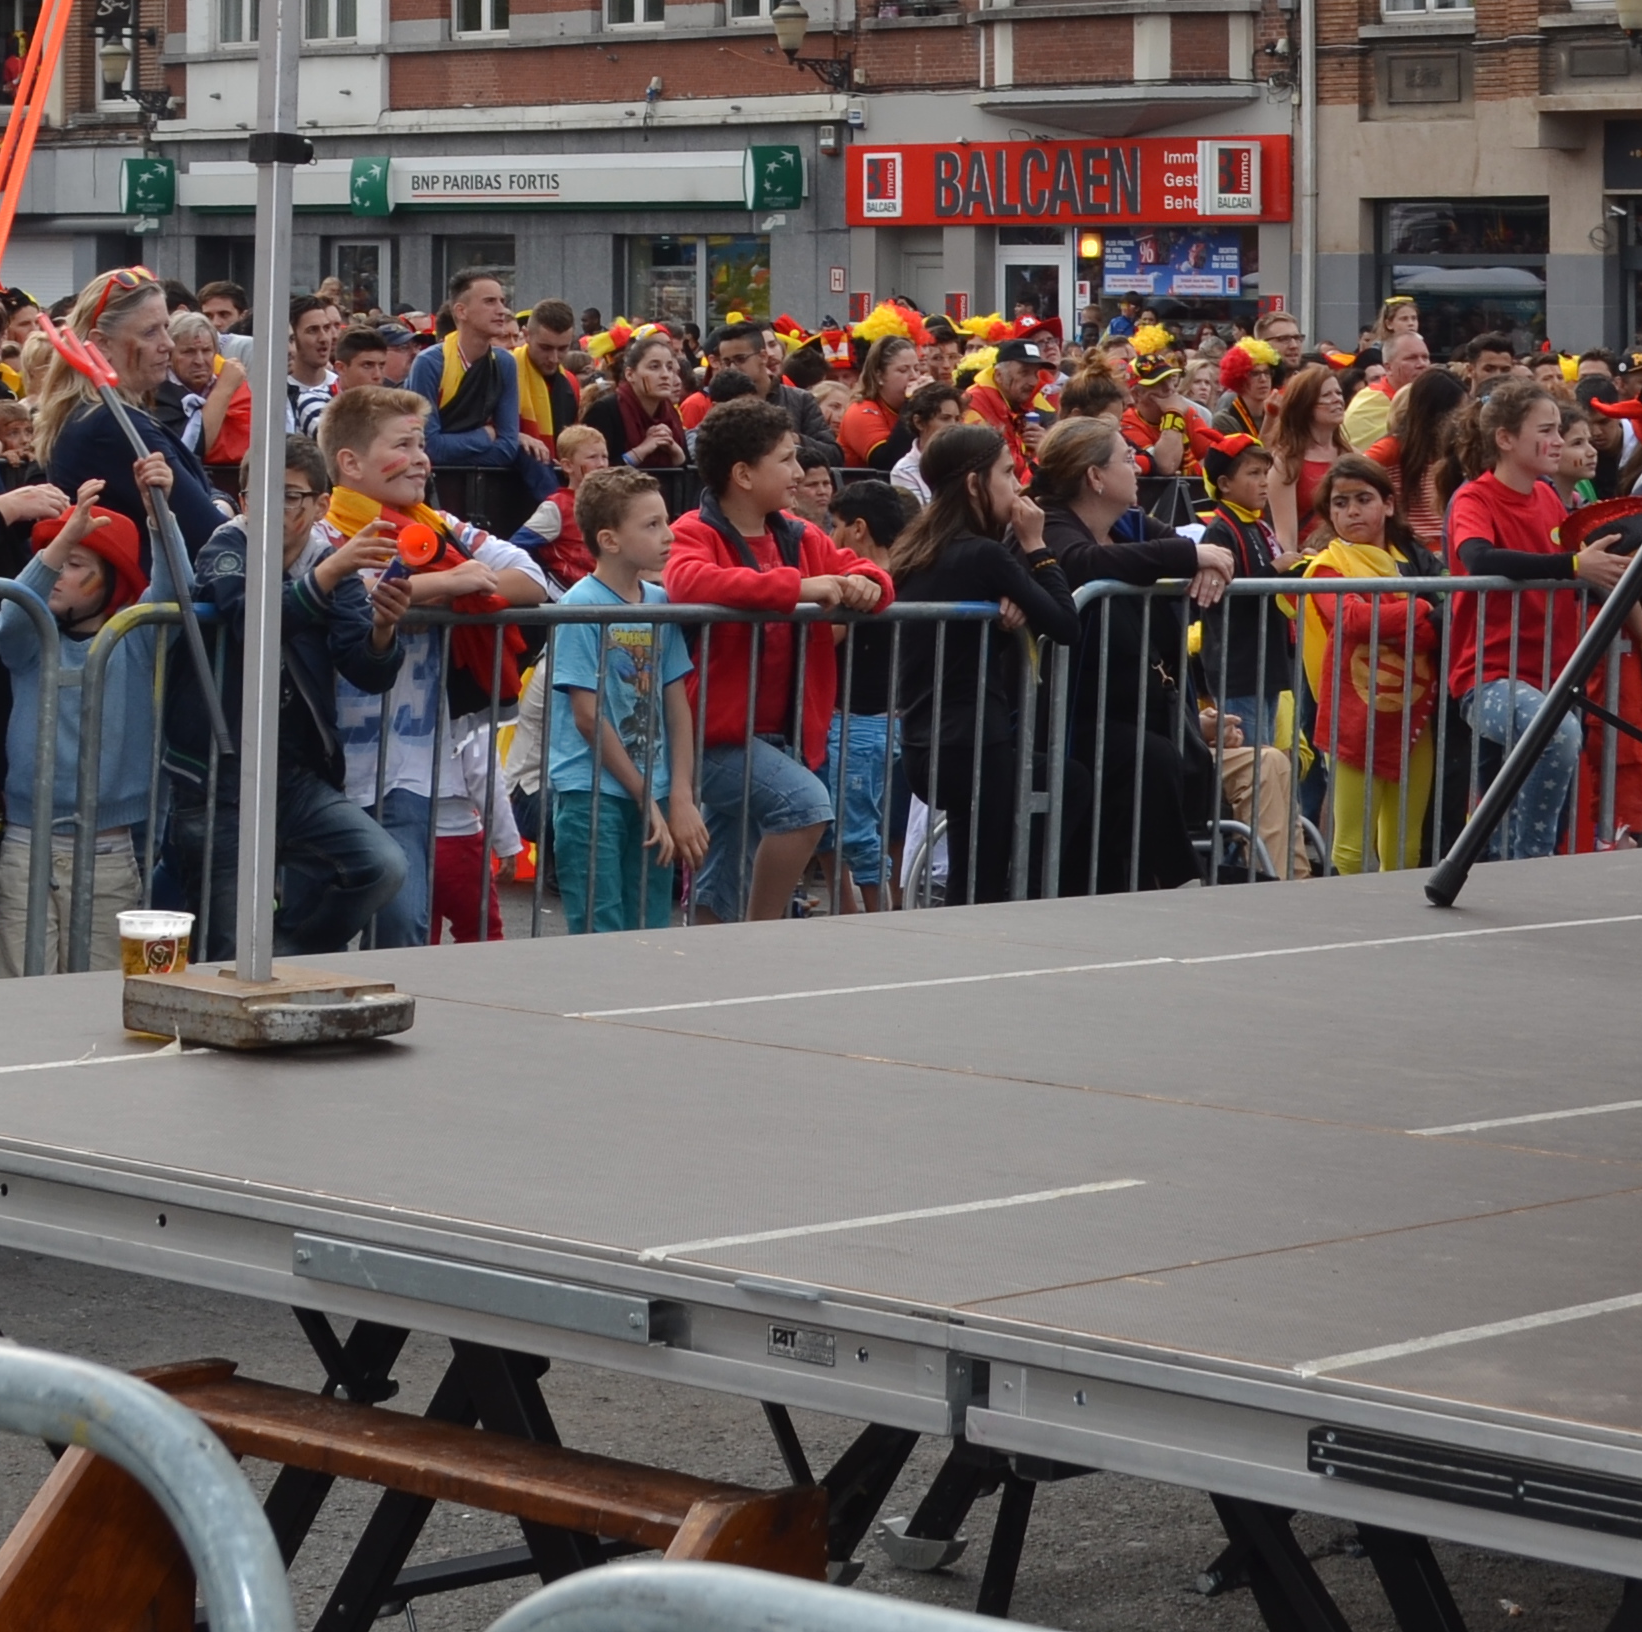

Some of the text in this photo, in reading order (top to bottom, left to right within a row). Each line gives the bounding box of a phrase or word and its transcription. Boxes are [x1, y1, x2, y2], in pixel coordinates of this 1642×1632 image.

[412, 173, 560, 191] BNP PARIBAS FORTIS
[886, 161, 895, 197] immo
[934, 147, 1141, 216] BALCAEN
[866, 201, 897, 213] BALCAEN
[1218, 197, 1252, 208] BALCAEN
[834, 271, 842, 288] H
